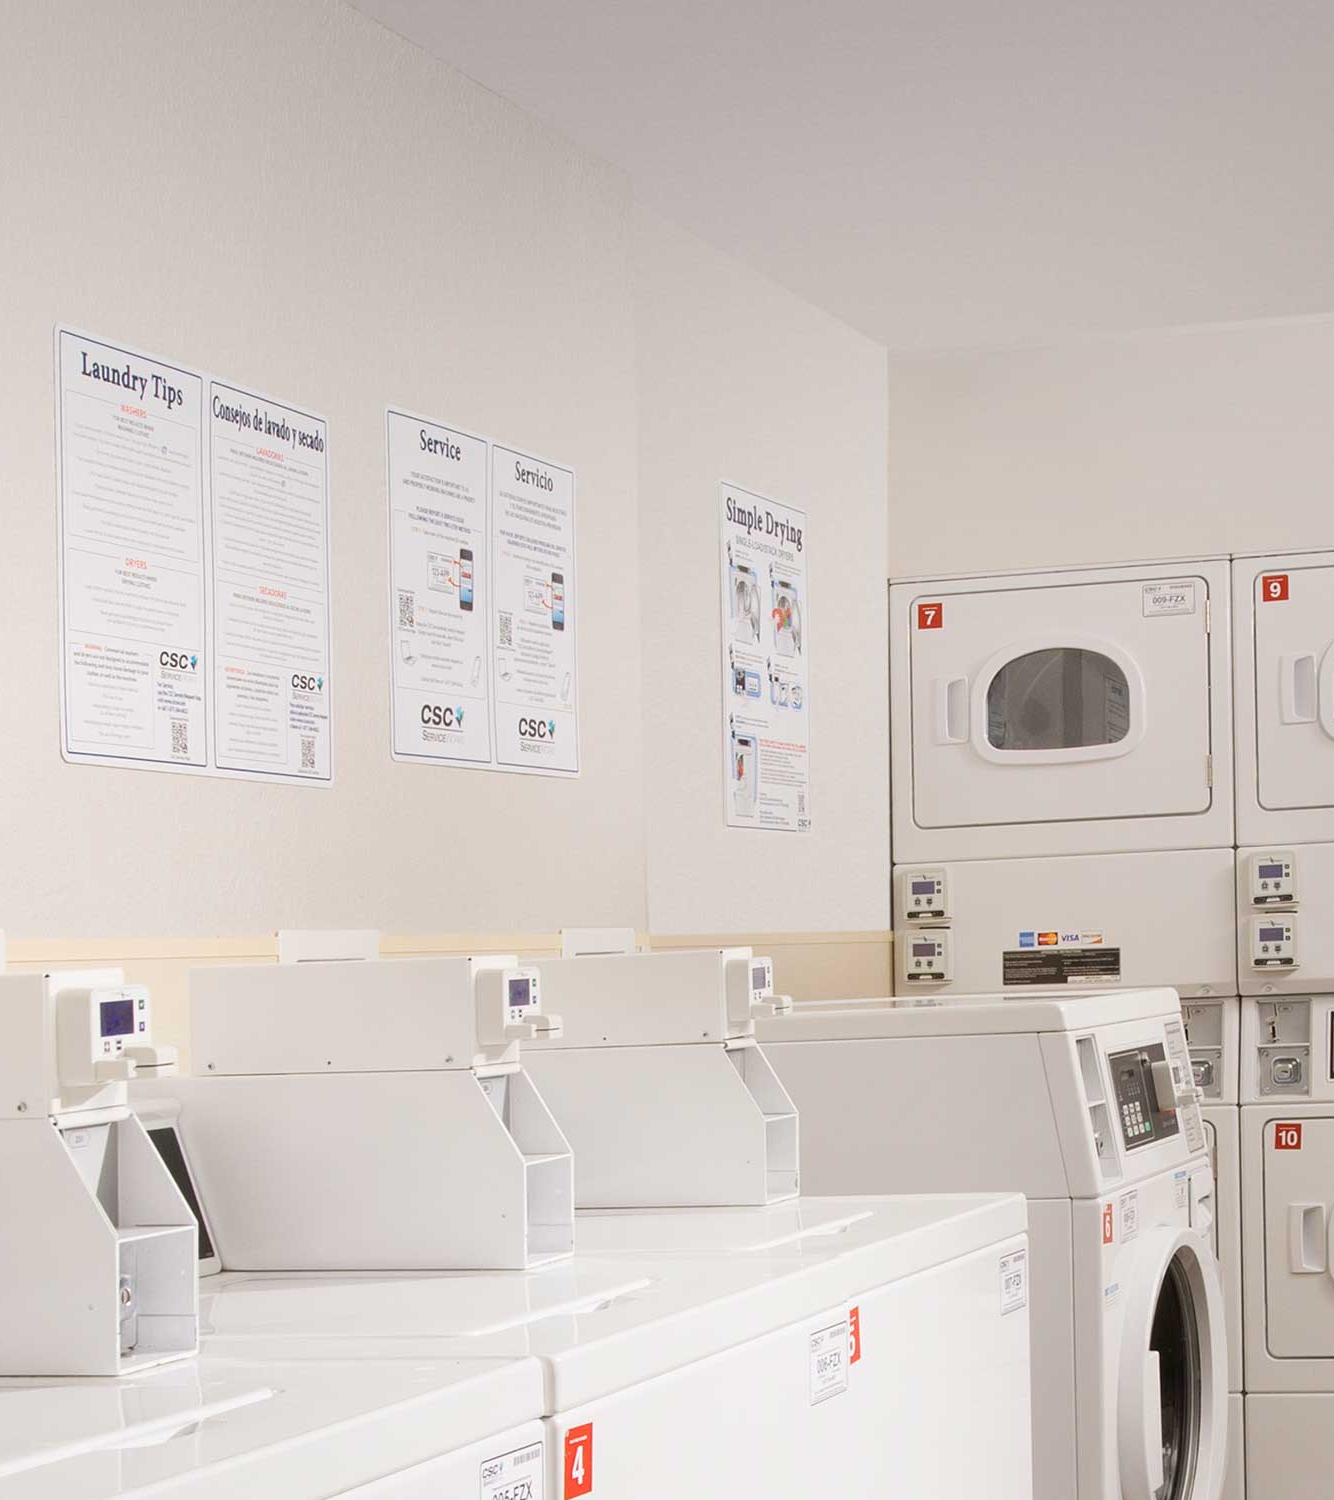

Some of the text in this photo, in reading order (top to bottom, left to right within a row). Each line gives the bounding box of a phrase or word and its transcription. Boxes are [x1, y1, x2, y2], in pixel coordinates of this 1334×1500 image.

[81, 351, 183, 410] Laundry Tips
[212, 395, 325, 453] Consejos de lavado y secado
[420, 429, 461, 461] Service
[515, 460, 554, 492] Servicio
[726, 497, 763, 535] Simple
[766, 511, 803, 552] Drying
[125, 557, 148, 570] DRYERS
[1269, 581, 1282, 599] 9
[924, 610, 937, 626] 7
[159, 651, 189, 670] CSC
[291, 674, 316, 692] CSC
[421, 704, 453, 727] CSC
[518, 717, 547, 738] CSC
[1061, 934, 1080, 943] VISA
[1278, 1129, 1299, 1148] 10
[1105, 1214, 1111, 1238] 6
[482, 1464, 499, 1479] CSC
[571, 1445, 585, 1485] 4
